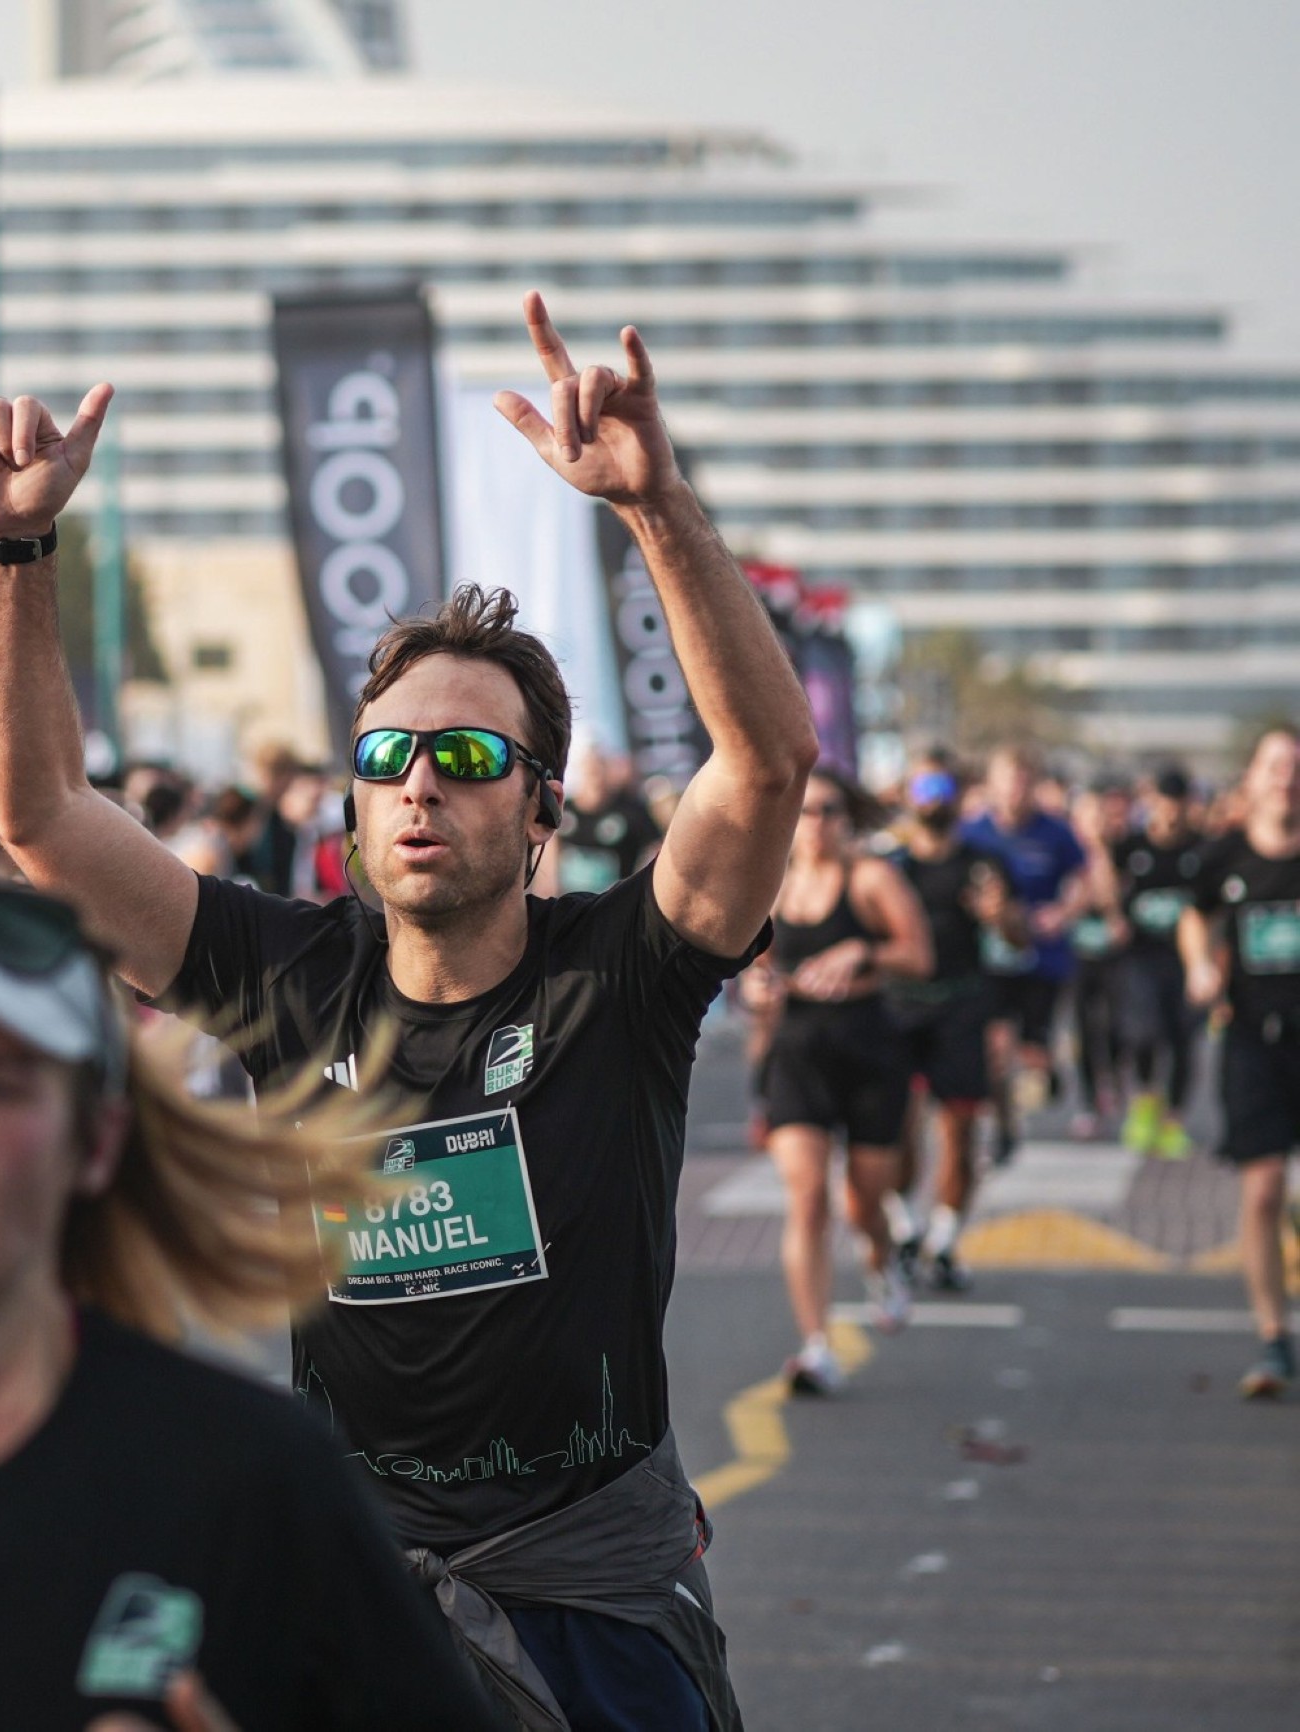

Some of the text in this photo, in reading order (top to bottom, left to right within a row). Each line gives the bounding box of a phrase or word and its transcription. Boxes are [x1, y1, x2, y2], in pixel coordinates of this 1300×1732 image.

[445, 1128, 496, 1153] DUBAI
[348, 1215, 489, 1261] MANUEL
[347, 1258, 505, 1285] DREAM BIG. RUN HARD. RACE ICONIC.
[405, 1283, 441, 1295] ICNIC
